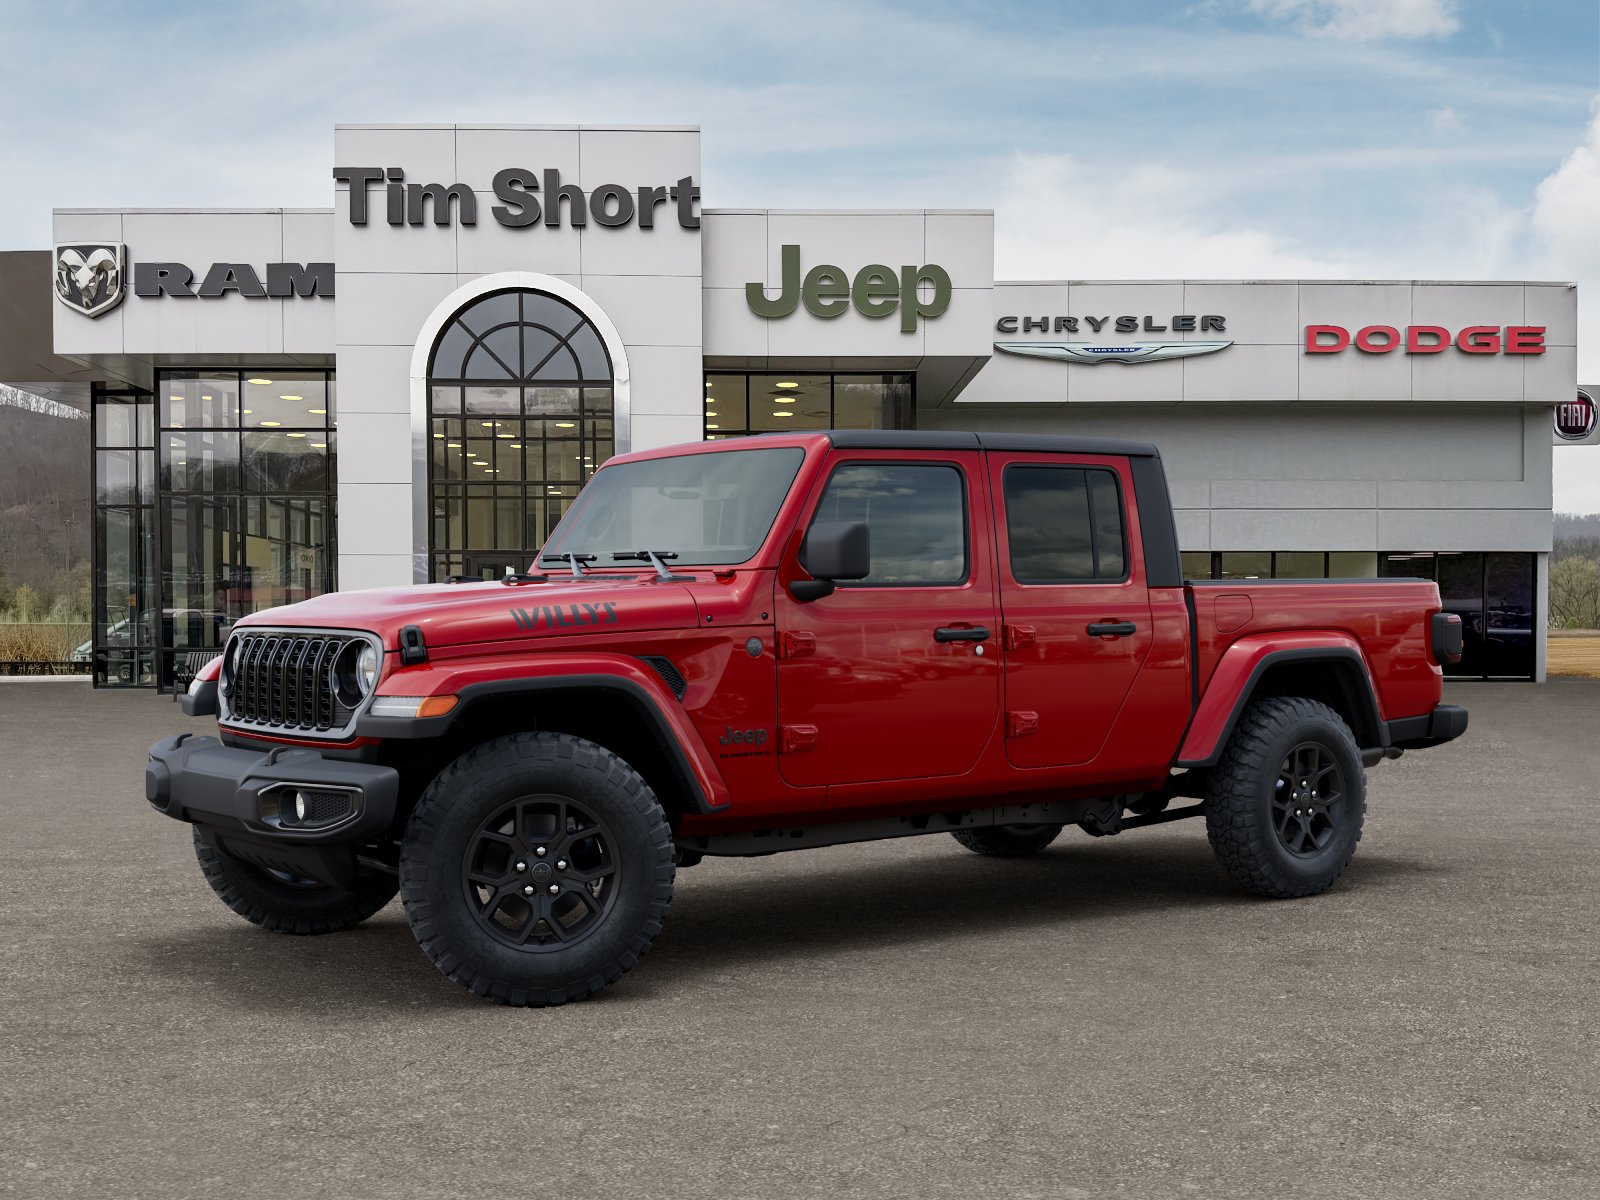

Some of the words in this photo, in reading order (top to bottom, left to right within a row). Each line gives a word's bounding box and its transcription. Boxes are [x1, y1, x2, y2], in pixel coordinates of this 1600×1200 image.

[333, 167, 477, 226] Tim
[491, 167, 701, 229] Short
[133, 262, 336, 297] RAM
[745, 244, 952, 333] Jeep
[996, 315, 1228, 333] CHRYSLER
[1304, 324, 1547, 354] DODGE
[1560, 404, 1586, 427] FIAT
[508, 601, 618, 630] WILLYS
[719, 725, 768, 747] Jeep
